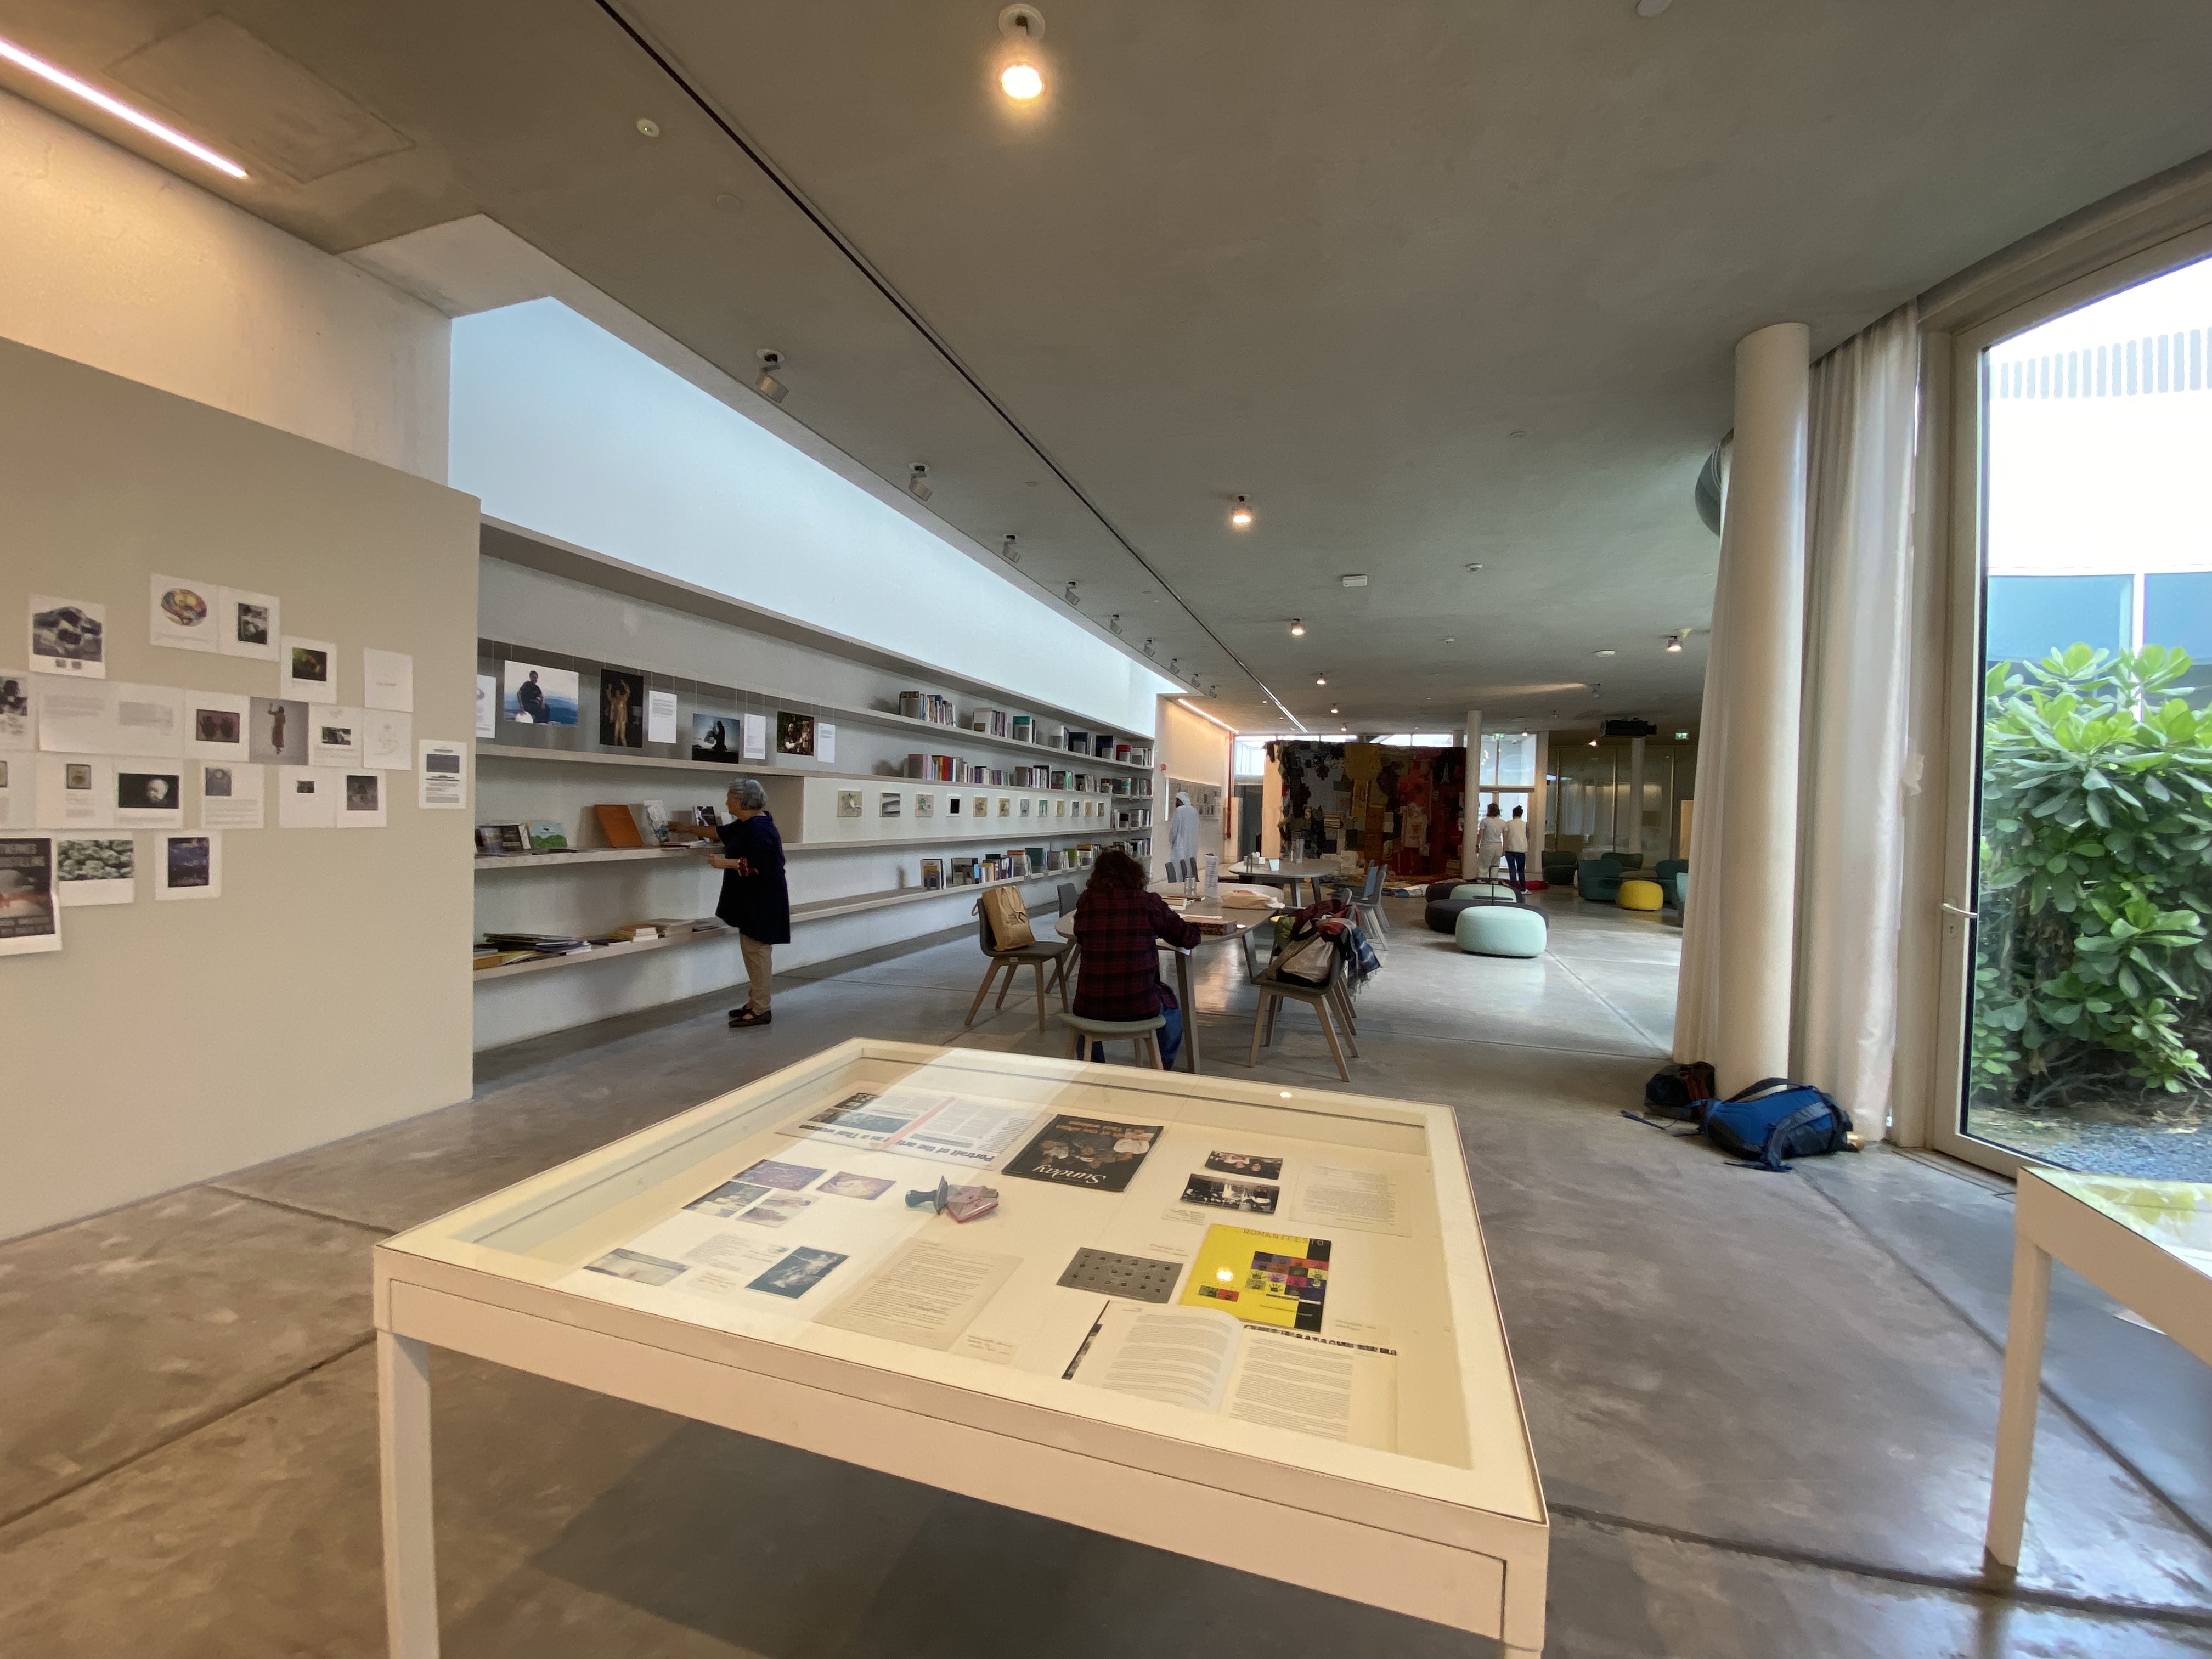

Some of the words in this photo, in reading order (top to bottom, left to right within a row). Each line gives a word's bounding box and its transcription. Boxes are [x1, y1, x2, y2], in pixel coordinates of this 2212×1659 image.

[883, 1137, 917, 1148] artit
[950, 1150, 995, 1162] Portrait
[1031, 1165, 1107, 1184] Sunday
